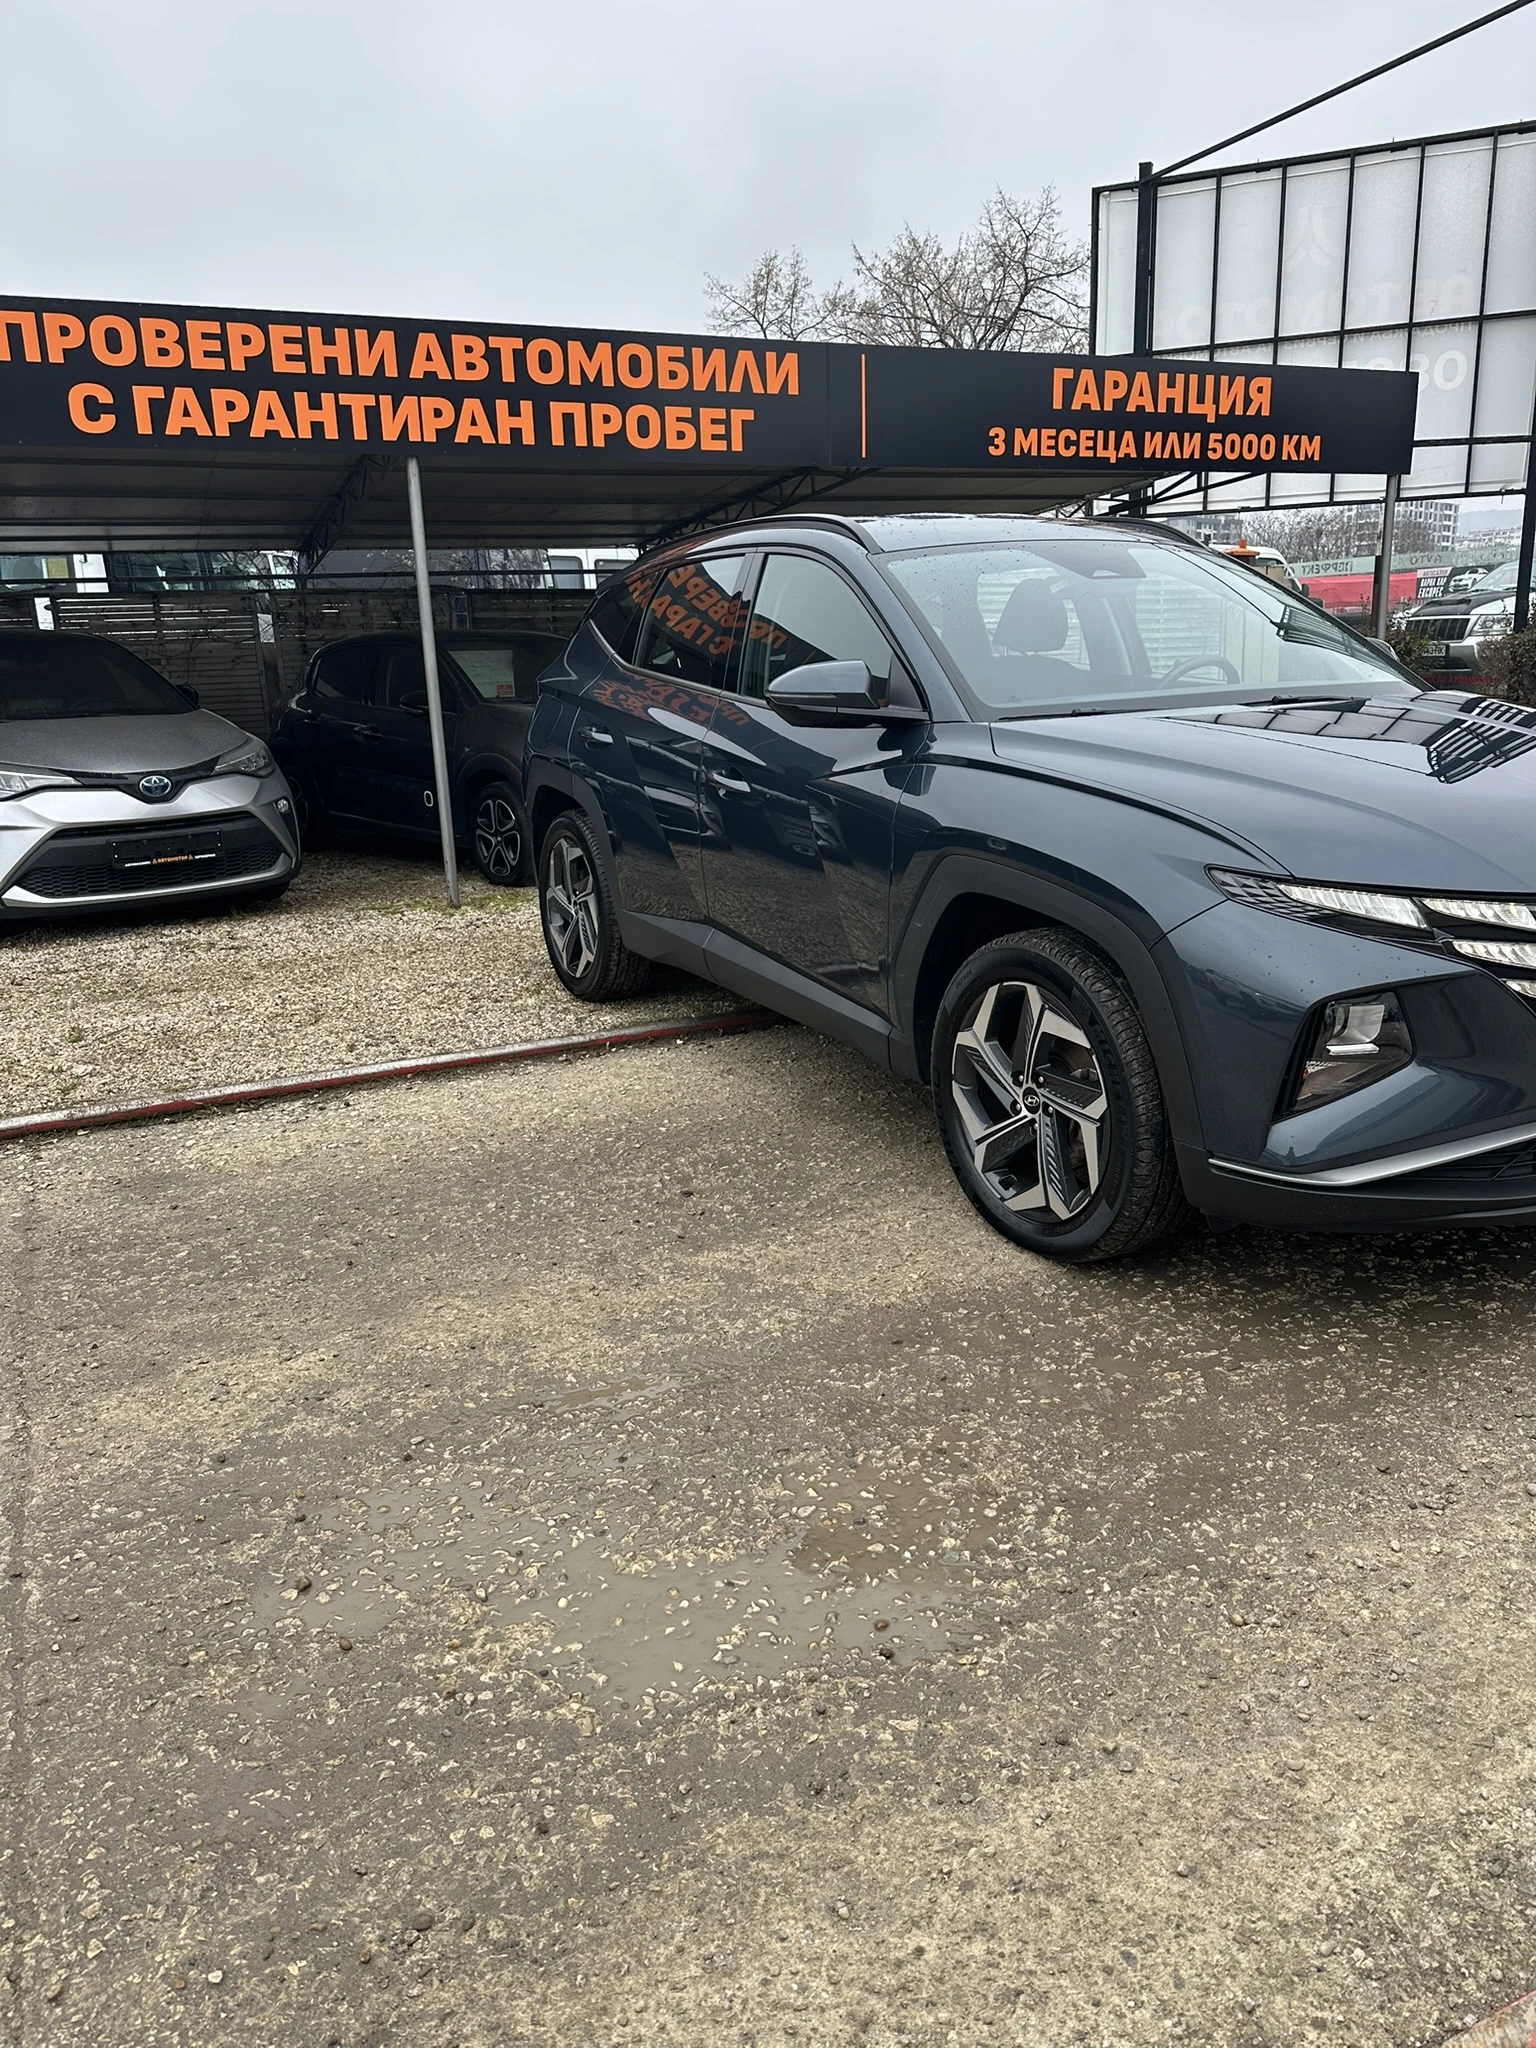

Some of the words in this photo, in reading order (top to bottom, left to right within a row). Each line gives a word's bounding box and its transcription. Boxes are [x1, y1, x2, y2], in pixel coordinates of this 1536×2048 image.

[0, 311, 397, 379] ПРОВЕРЕНИ
[410, 332, 799, 395] АВТОМОБИЛИ
[67, 383, 116, 434] С
[133, 387, 535, 445] ГАРАНТИРАН
[549, 403, 755, 452] ПРОБЕГ
[1052, 367, 1273, 423] ГАРАНЦИЯ
[1013, 428, 1137, 463] МЕСЕЦА
[1144, 432, 1201, 459] ИЛИ
[1207, 433, 1276, 461] 5000
[1281, 435, 1322, 461] КМ
